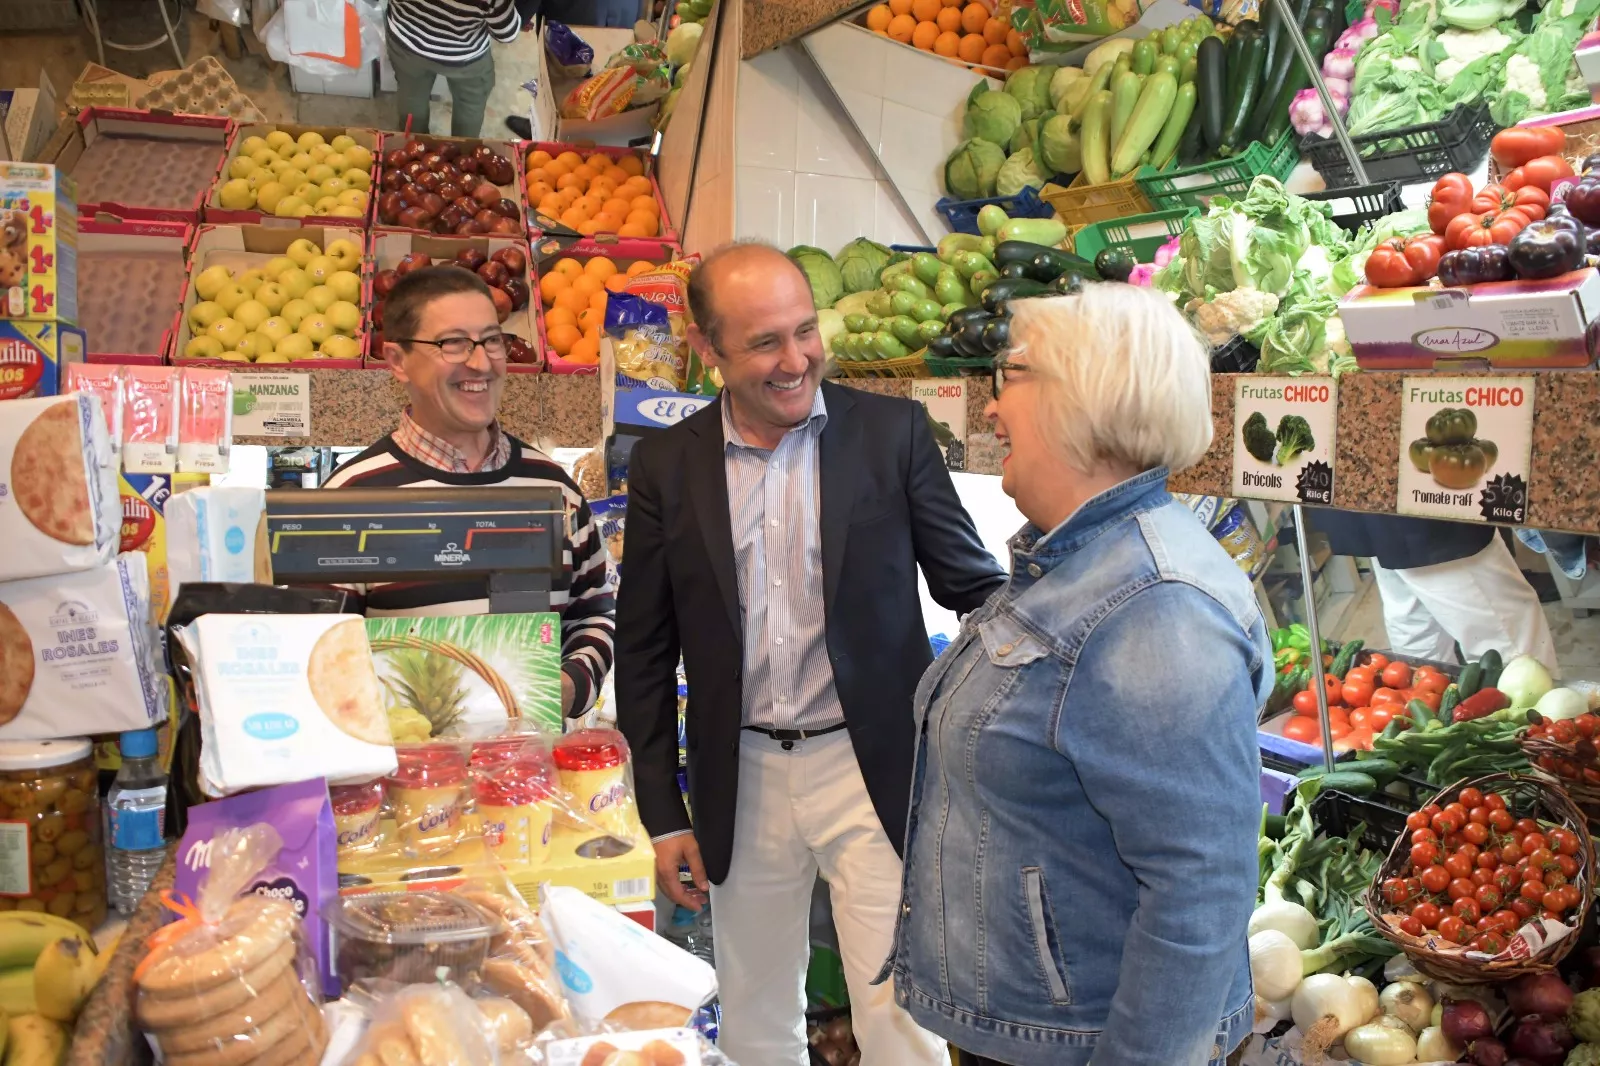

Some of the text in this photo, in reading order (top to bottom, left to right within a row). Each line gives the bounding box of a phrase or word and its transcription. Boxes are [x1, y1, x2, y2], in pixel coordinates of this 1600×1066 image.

[1451, 331, 1484, 350] Azul
[249, 384, 299, 396] MANZANAS
[915, 385, 962, 398] Frutas CHICO
[1242, 385, 1329, 403] Frutas CHICO
[1410, 387, 1524, 407] Frutas CHICO
[1306, 490, 1322, 499] Kilo
[1412, 489, 1474, 507] Tomate raff
[1493, 507, 1513, 517] Kilo
[434, 553, 471, 562] MINERVA
[57, 627, 97, 643] INES
[41, 639, 119, 661] ROSALES
[255, 885, 293, 898] Choco
